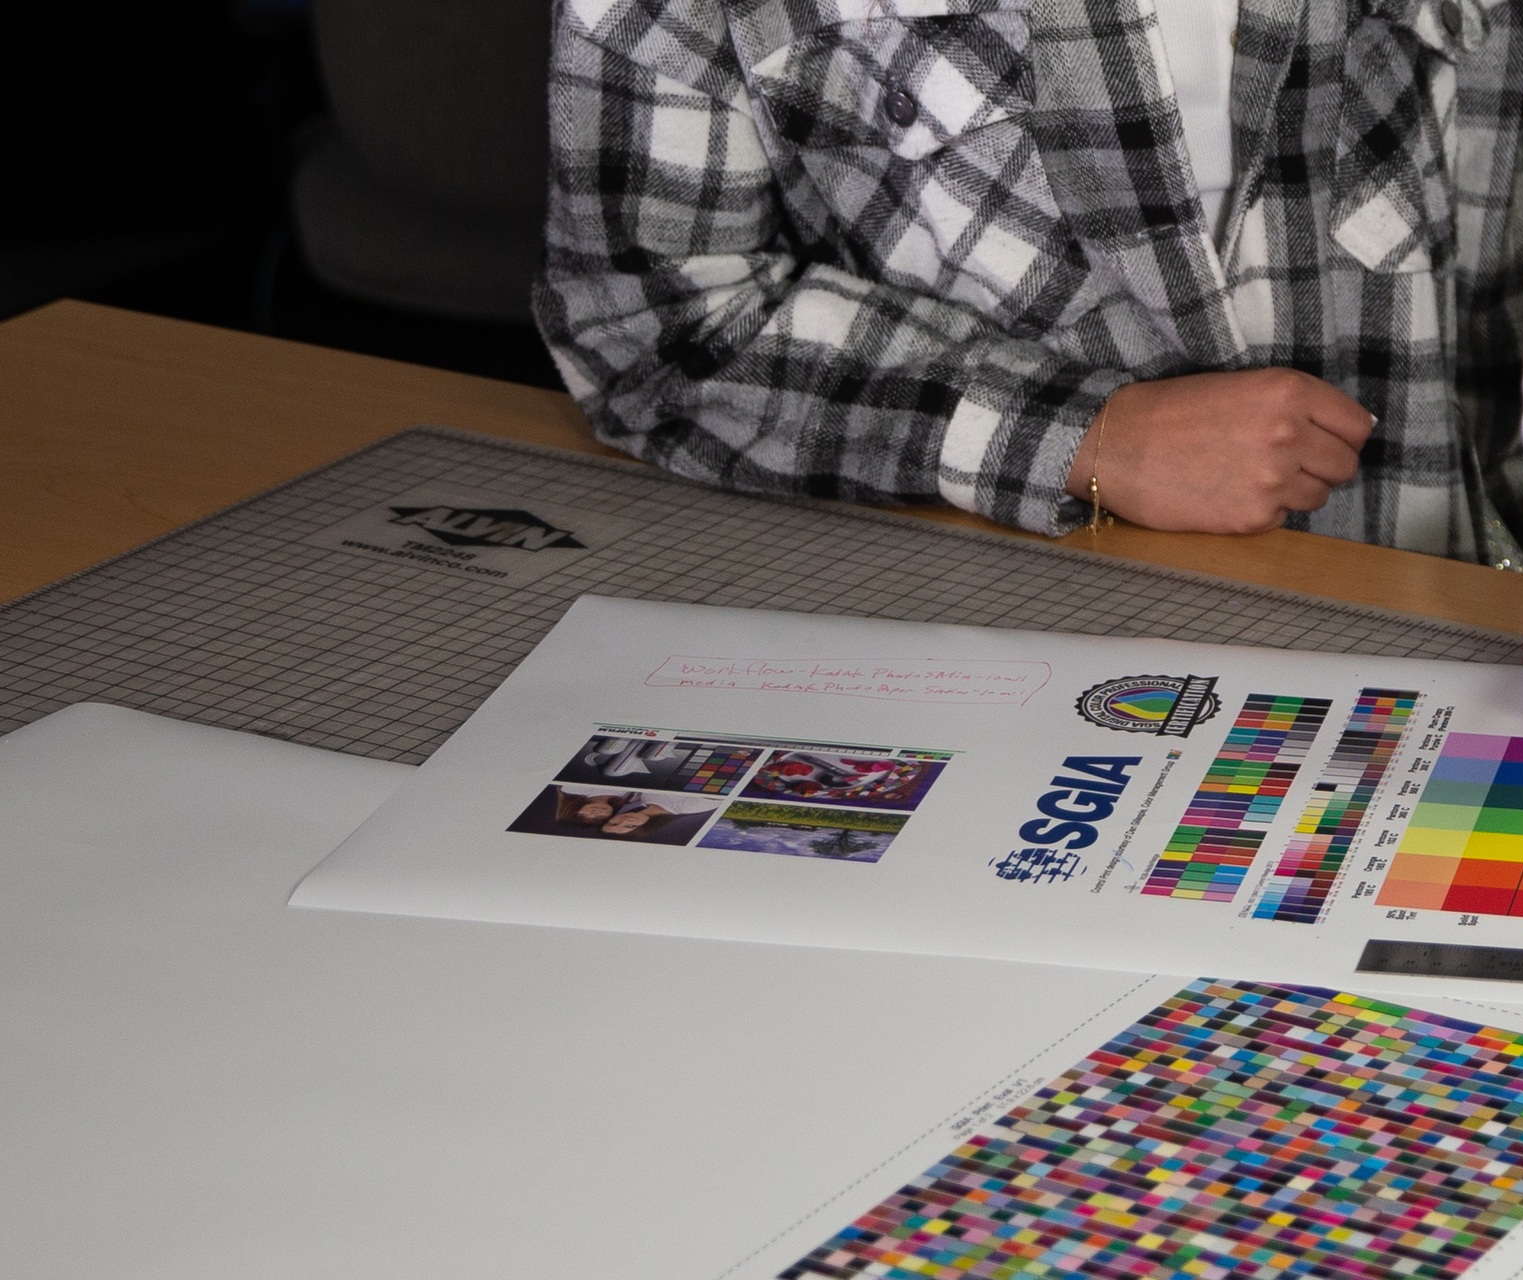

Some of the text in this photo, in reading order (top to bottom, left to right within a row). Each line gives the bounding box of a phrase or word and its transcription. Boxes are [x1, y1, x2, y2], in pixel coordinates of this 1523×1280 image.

[341, 540, 508, 578] www.alvinco.com
[1099, 680, 1184, 697] PROFESSIONAL
[1163, 678, 1211, 735] CERTIFICATION
[1419, 734, 1433, 750] Pantone
[1408, 757, 1422, 773] Pantone
[1397, 780, 1412, 796] Pantone
[1018, 756, 1143, 850] SGIA
[1386, 804, 1401, 821] Pantone
[1374, 829, 1390, 847] Pantone
[1351, 881, 1366, 899] Pantone
